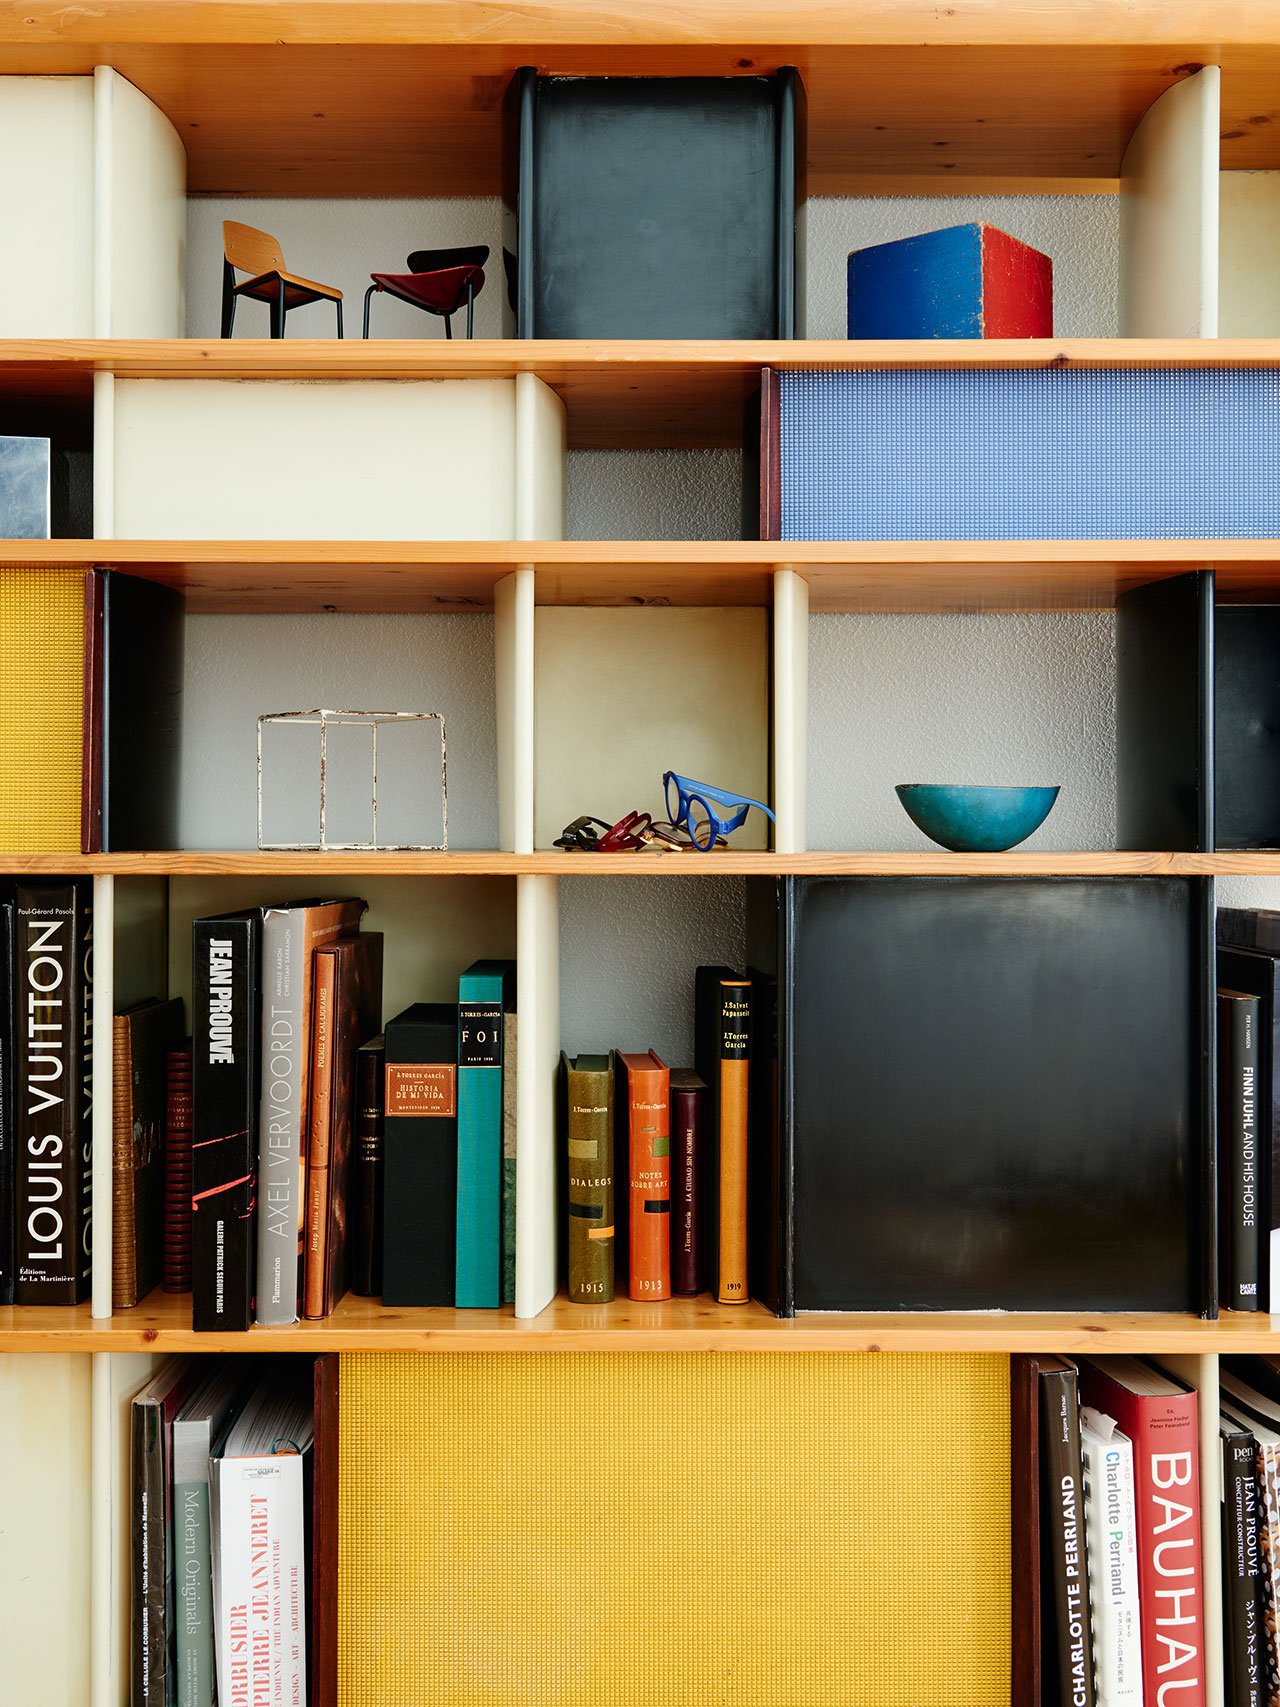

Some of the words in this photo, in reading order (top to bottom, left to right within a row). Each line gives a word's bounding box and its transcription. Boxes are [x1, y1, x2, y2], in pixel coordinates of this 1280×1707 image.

[209, 938, 233, 985] JEAN
[27, 920, 64, 1114] VUITTON
[209, 986, 234, 1064] PROUVÉ
[268, 1005, 293, 1167] VERVOORDT
[1243, 1066, 1254, 1096] FINN
[1243, 1098, 1254, 1129] JUHL
[1243, 1132, 1254, 1159] AND
[570, 1178, 611, 1187] DIALEGS
[1243, 1163, 1254, 1182] HIS
[28, 1134, 64, 1260] LOUIS
[267, 1178, 290, 1238] AXEL
[685, 1193, 692, 1202] LA
[1243, 1184, 1255, 1227] HOUSE
[216, 1220, 224, 1244] GALERIE
[311, 1233, 319, 1252] Josep
[20, 1266, 46, 1274] Éditions
[216, 1246, 224, 1271] PATRICK
[272, 1257, 281, 1304] Flammarion
[581, 1283, 604, 1293] 1915
[639, 1280, 662, 1290] 1913
[1234, 1447, 1253, 1460] pen
[1106, 1452, 1121, 1525] Charlotte
[1242, 1476, 1256, 1512] JEAN
[184, 1490, 200, 1555] Modern
[1061, 1475, 1079, 1577] PERRIAND
[1235, 1477, 1244, 1576] CONCEPTEUR-CONSTRUCTEUR
[250, 1494, 269, 1621] JEANNERET
[1110, 1531, 1126, 1596] Perriand
[1246, 1517, 1259, 1576] PROUVÉ
[181, 1559, 201, 1635] Originals
[290, 1565, 298, 1632] ARCHITECTURE
[1151, 1451, 1198, 1707] BAUHAU
[143, 1646, 148, 1655] LE
[291, 1644, 299, 1661] ART
[1067, 1583, 1086, 1707] CHARLOTTE
[252, 1629, 270, 1707] PIERRE
[291, 1673, 300, 1705] DESIGN
[143, 1688, 148, 1696] LA
